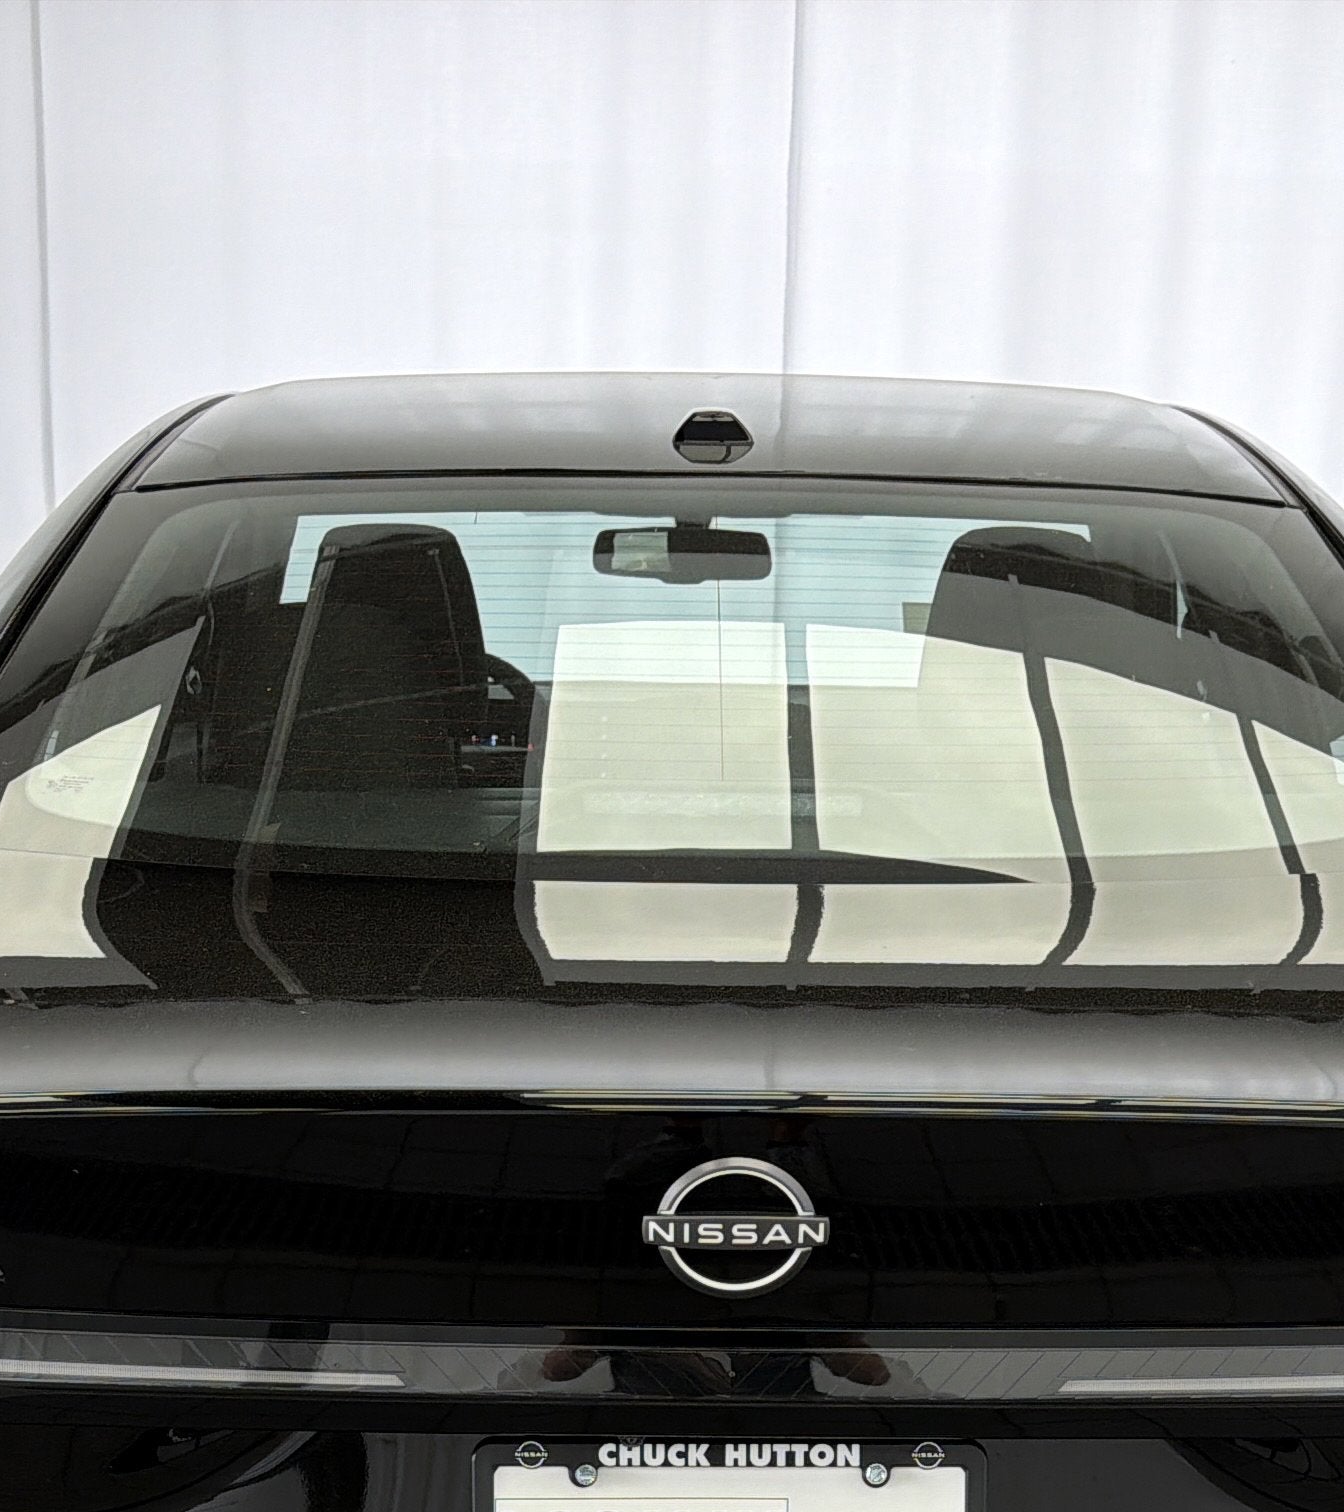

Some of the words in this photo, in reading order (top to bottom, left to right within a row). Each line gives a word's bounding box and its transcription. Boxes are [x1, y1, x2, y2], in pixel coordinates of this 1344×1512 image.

[648, 1220, 825, 1245] NISSAN
[598, 1443, 710, 1467] CHUCK
[724, 1443, 861, 1467] HUTTON
